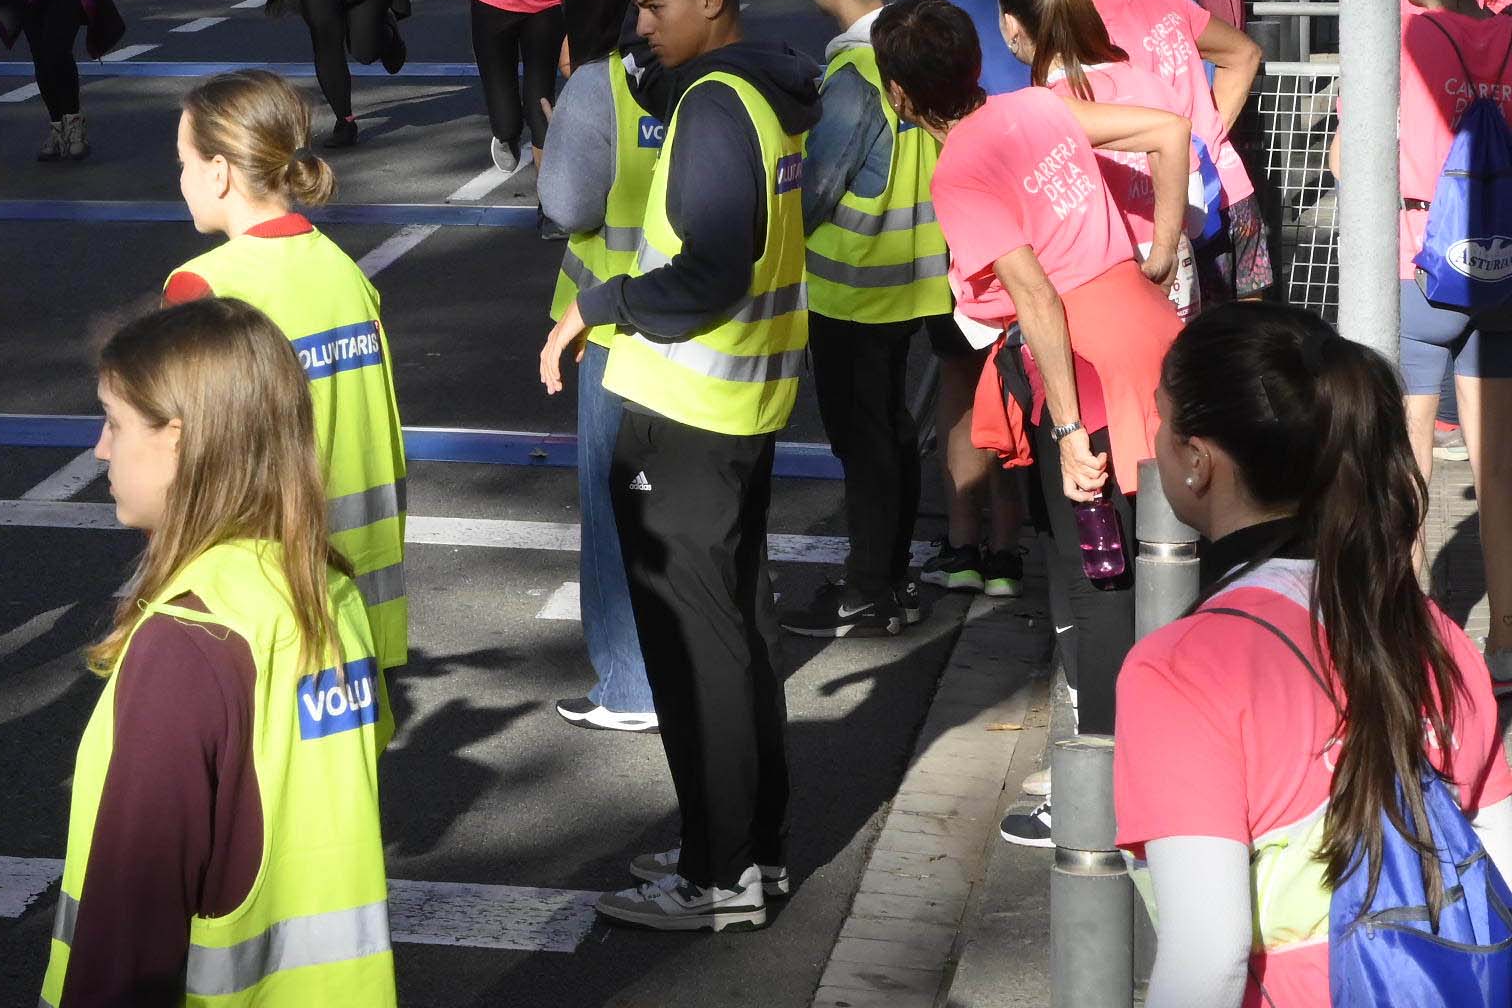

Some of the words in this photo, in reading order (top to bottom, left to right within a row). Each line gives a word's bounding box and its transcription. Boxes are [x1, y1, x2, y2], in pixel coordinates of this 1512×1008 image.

[1023, 135, 1078, 194] CARRERA
[1044, 176, 1066, 203] DE
[1063, 161, 1082, 186] LA
[1053, 174, 1097, 221] MUJER
[298, 339, 379, 371] OLUNTARIS
[629, 481, 652, 491] adidas
